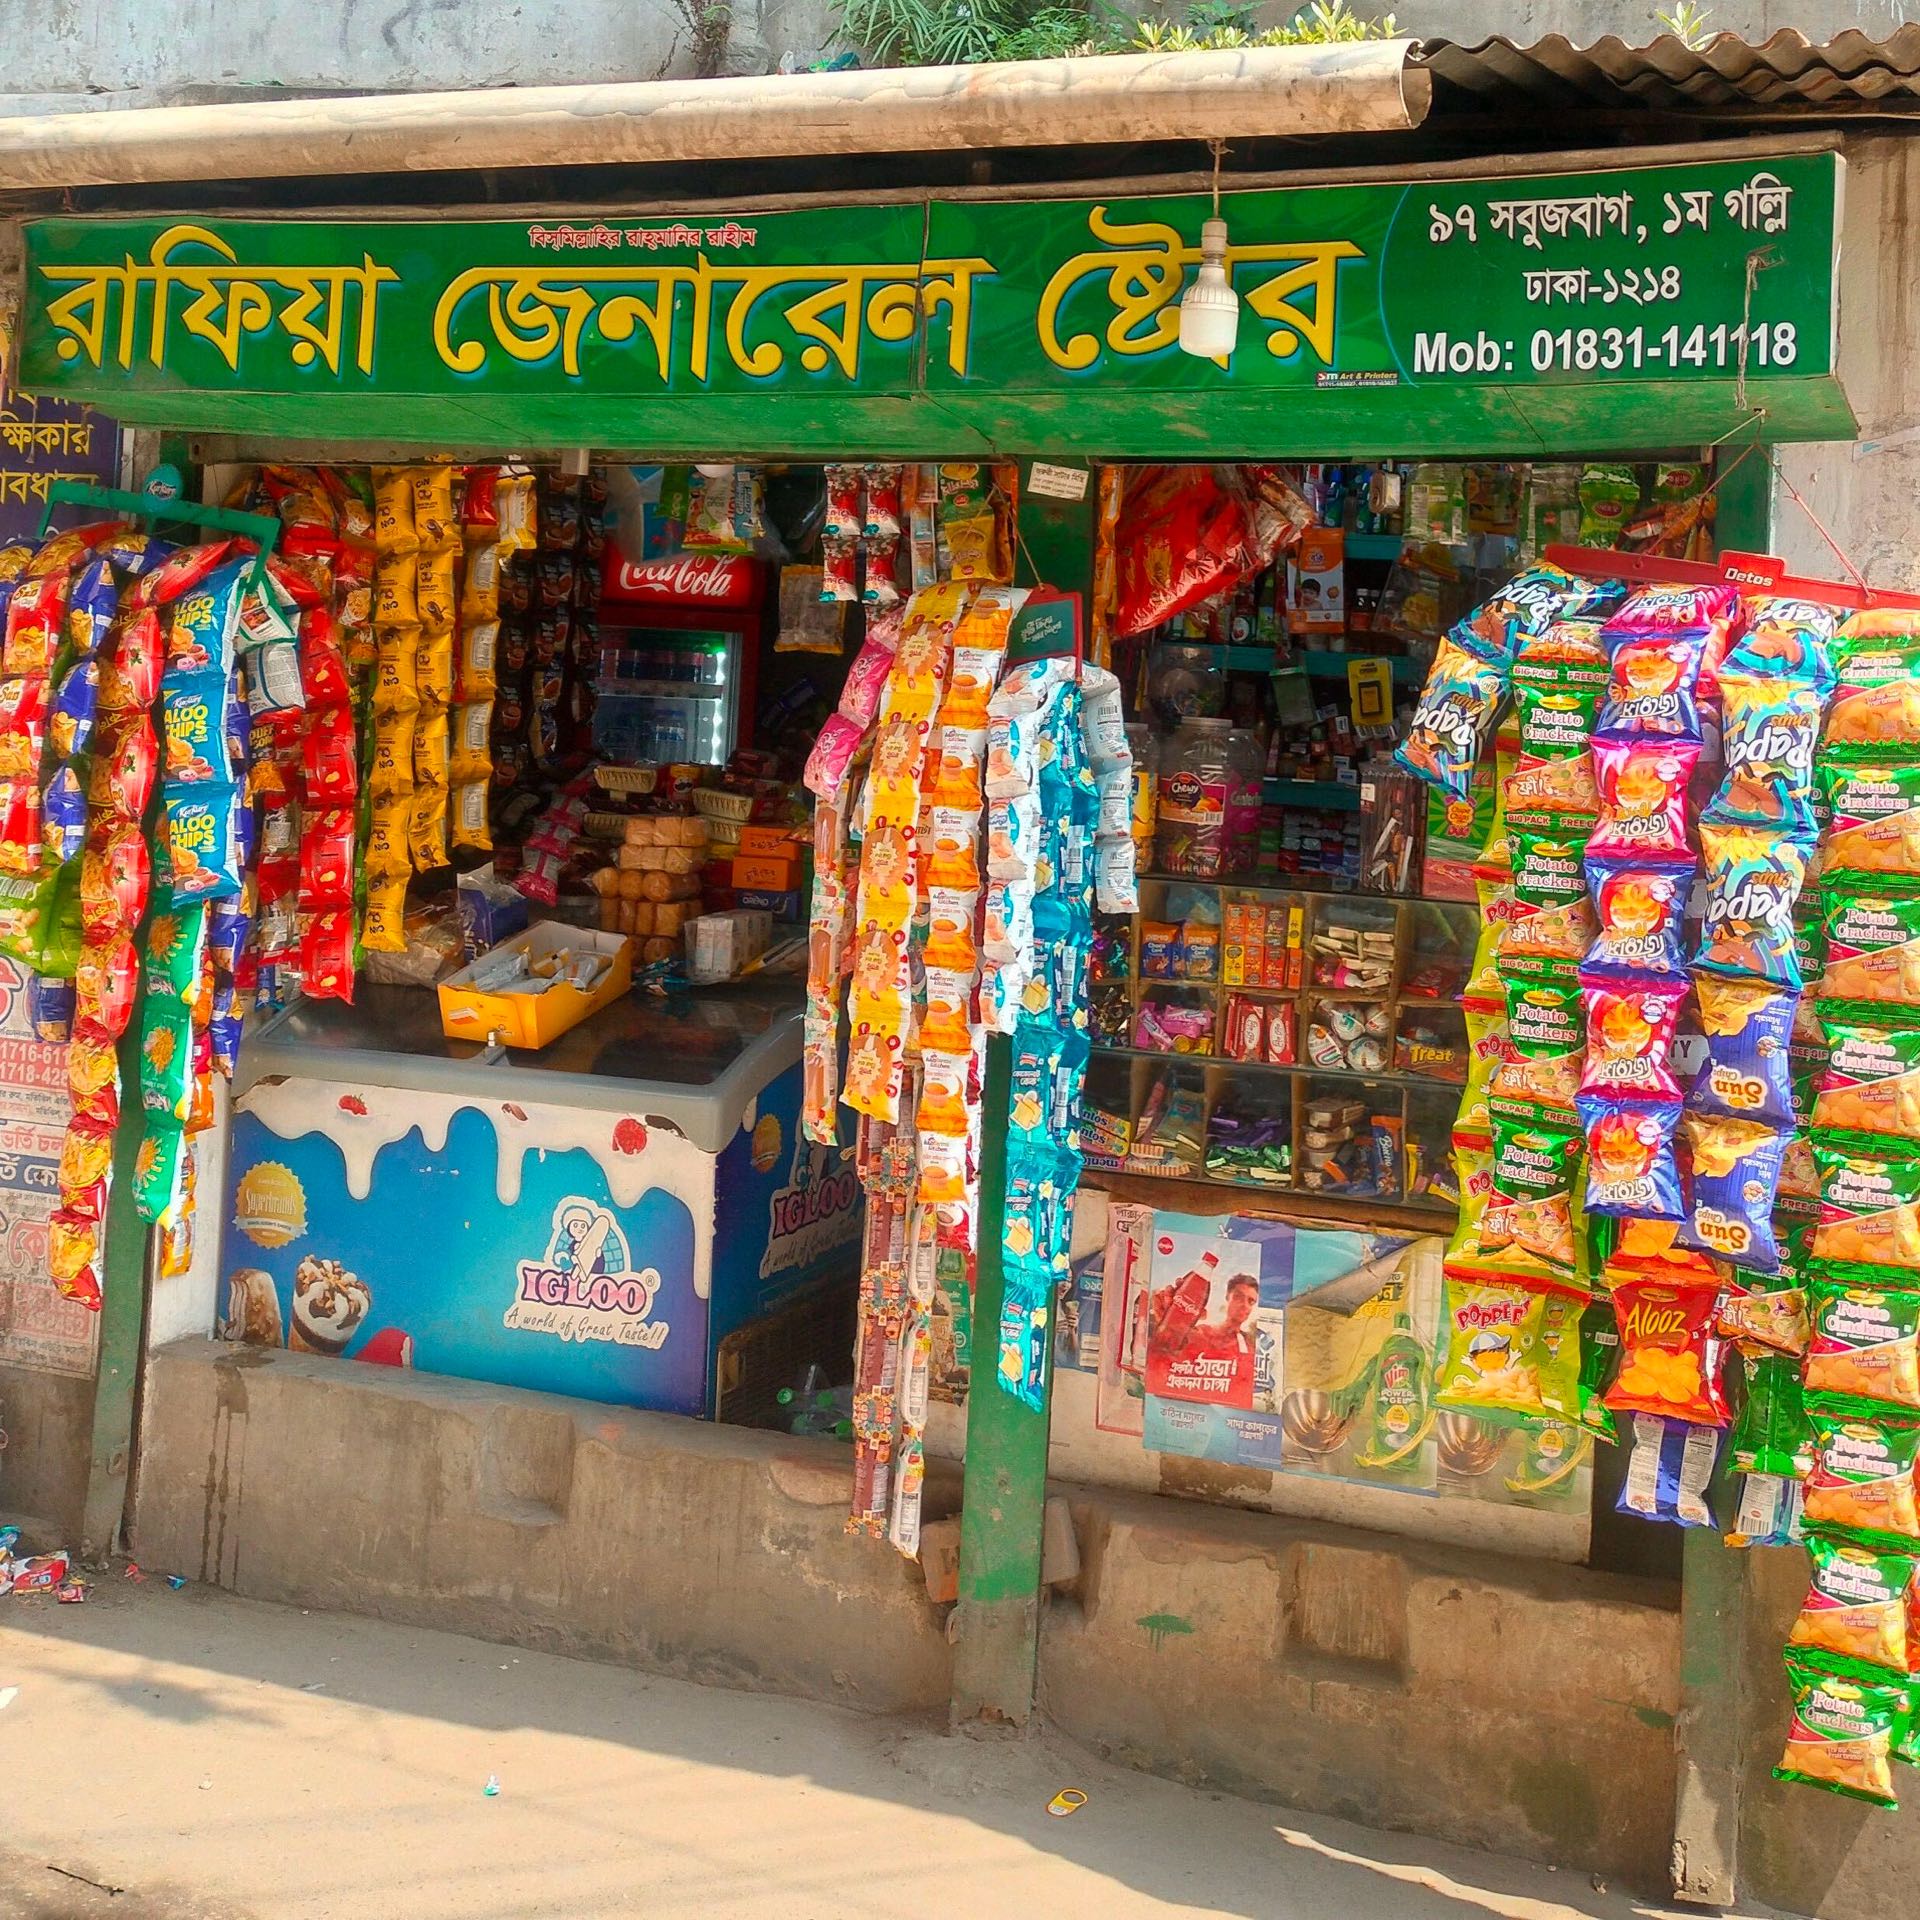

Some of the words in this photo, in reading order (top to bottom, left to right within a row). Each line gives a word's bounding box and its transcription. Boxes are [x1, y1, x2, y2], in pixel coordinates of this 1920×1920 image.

[1427, 202, 1478, 243] ৯৭
[1662, 191, 1713, 233] ১ম
[706, 223, 757, 248] রাহীম
[1522, 265, 1681, 306] ঢাকা-১২১৪
[38, 224, 402, 377] রাফিয়া
[433, 251, 998, 384] জেনারেল
[1414, 331, 1515, 374] Mob:
[1530, 321, 1797, 370] 01831-141118
[1724, 567, 1774, 587] Detos
[175, 610, 212, 627] HIPS
[1851, 656, 1902, 667] Potato
[1514, 666, 1531, 676] BIG
[1532, 668, 1558, 679] PACK
[1568, 671, 1591, 681] FREE
[1592, 672, 1609, 682] GIF
[1840, 667, 1911, 679] Crackers
[165, 704, 208, 724] ALOO
[1411, 702, 1477, 746] Papa
[1531, 708, 1584, 727] Potato
[1522, 725, 1590, 743] Crackers
[1728, 728, 1813, 769] Papa
[1848, 781, 1900, 795] Potato
[1838, 794, 1909, 809] Crackers
[169, 814, 216, 834] ALOO
[1507, 814, 1523, 823] BIG
[1524, 816, 1549, 825] PACK
[1561, 818, 1584, 827] FREE
[1524, 854, 1577, 873] Potato
[1516, 870, 1585, 891] Crackers
[1709, 884, 1790, 927] Papa
[1845, 908, 1897, 925] Potato
[1837, 925, 1907, 941] Crackers
[1500, 958, 1516, 970] BIG
[1517, 962, 1543, 973] PACK
[1553, 964, 1579, 975] FREE
[1516, 1003, 1568, 1024] Potato
[1509, 1019, 1576, 1042] Crackers
[1410, 1045, 1454, 1065] Treat
[1841, 1041, 1897, 1057] Potato
[1832, 1056, 1905, 1073] Crackers
[1715, 1078, 1763, 1105] Sun
[1083, 1109, 1108, 1126] ntos
[1509, 1104, 1535, 1115] PACK
[1544, 1111, 1568, 1123] FREE
[1081, 1128, 1107, 1144] ntos
[1502, 1145, 1553, 1167] Potato
[1496, 1161, 1557, 1185] Crackers
[246, 1187, 297, 1216] Superbrands
[1781, 1199, 1807, 1210] FREE
[1699, 1221, 1746, 1251] Sun
[522, 1267, 647, 1315] IGLOO
[508, 1307, 519, 1323] A
[523, 1311, 554, 1328] world
[560, 1316, 573, 1337] of
[578, 1316, 612, 1337] Great
[1625, 1301, 1688, 1340] Alooz
[1381, 1389, 1415, 1398] POWER
[1829, 1556, 1882, 1582] Potato
[1818, 1571, 1890, 1600] Crackers
[1812, 1690, 1865, 1717] Potato
[1805, 1707, 1874, 1735] Crackers
